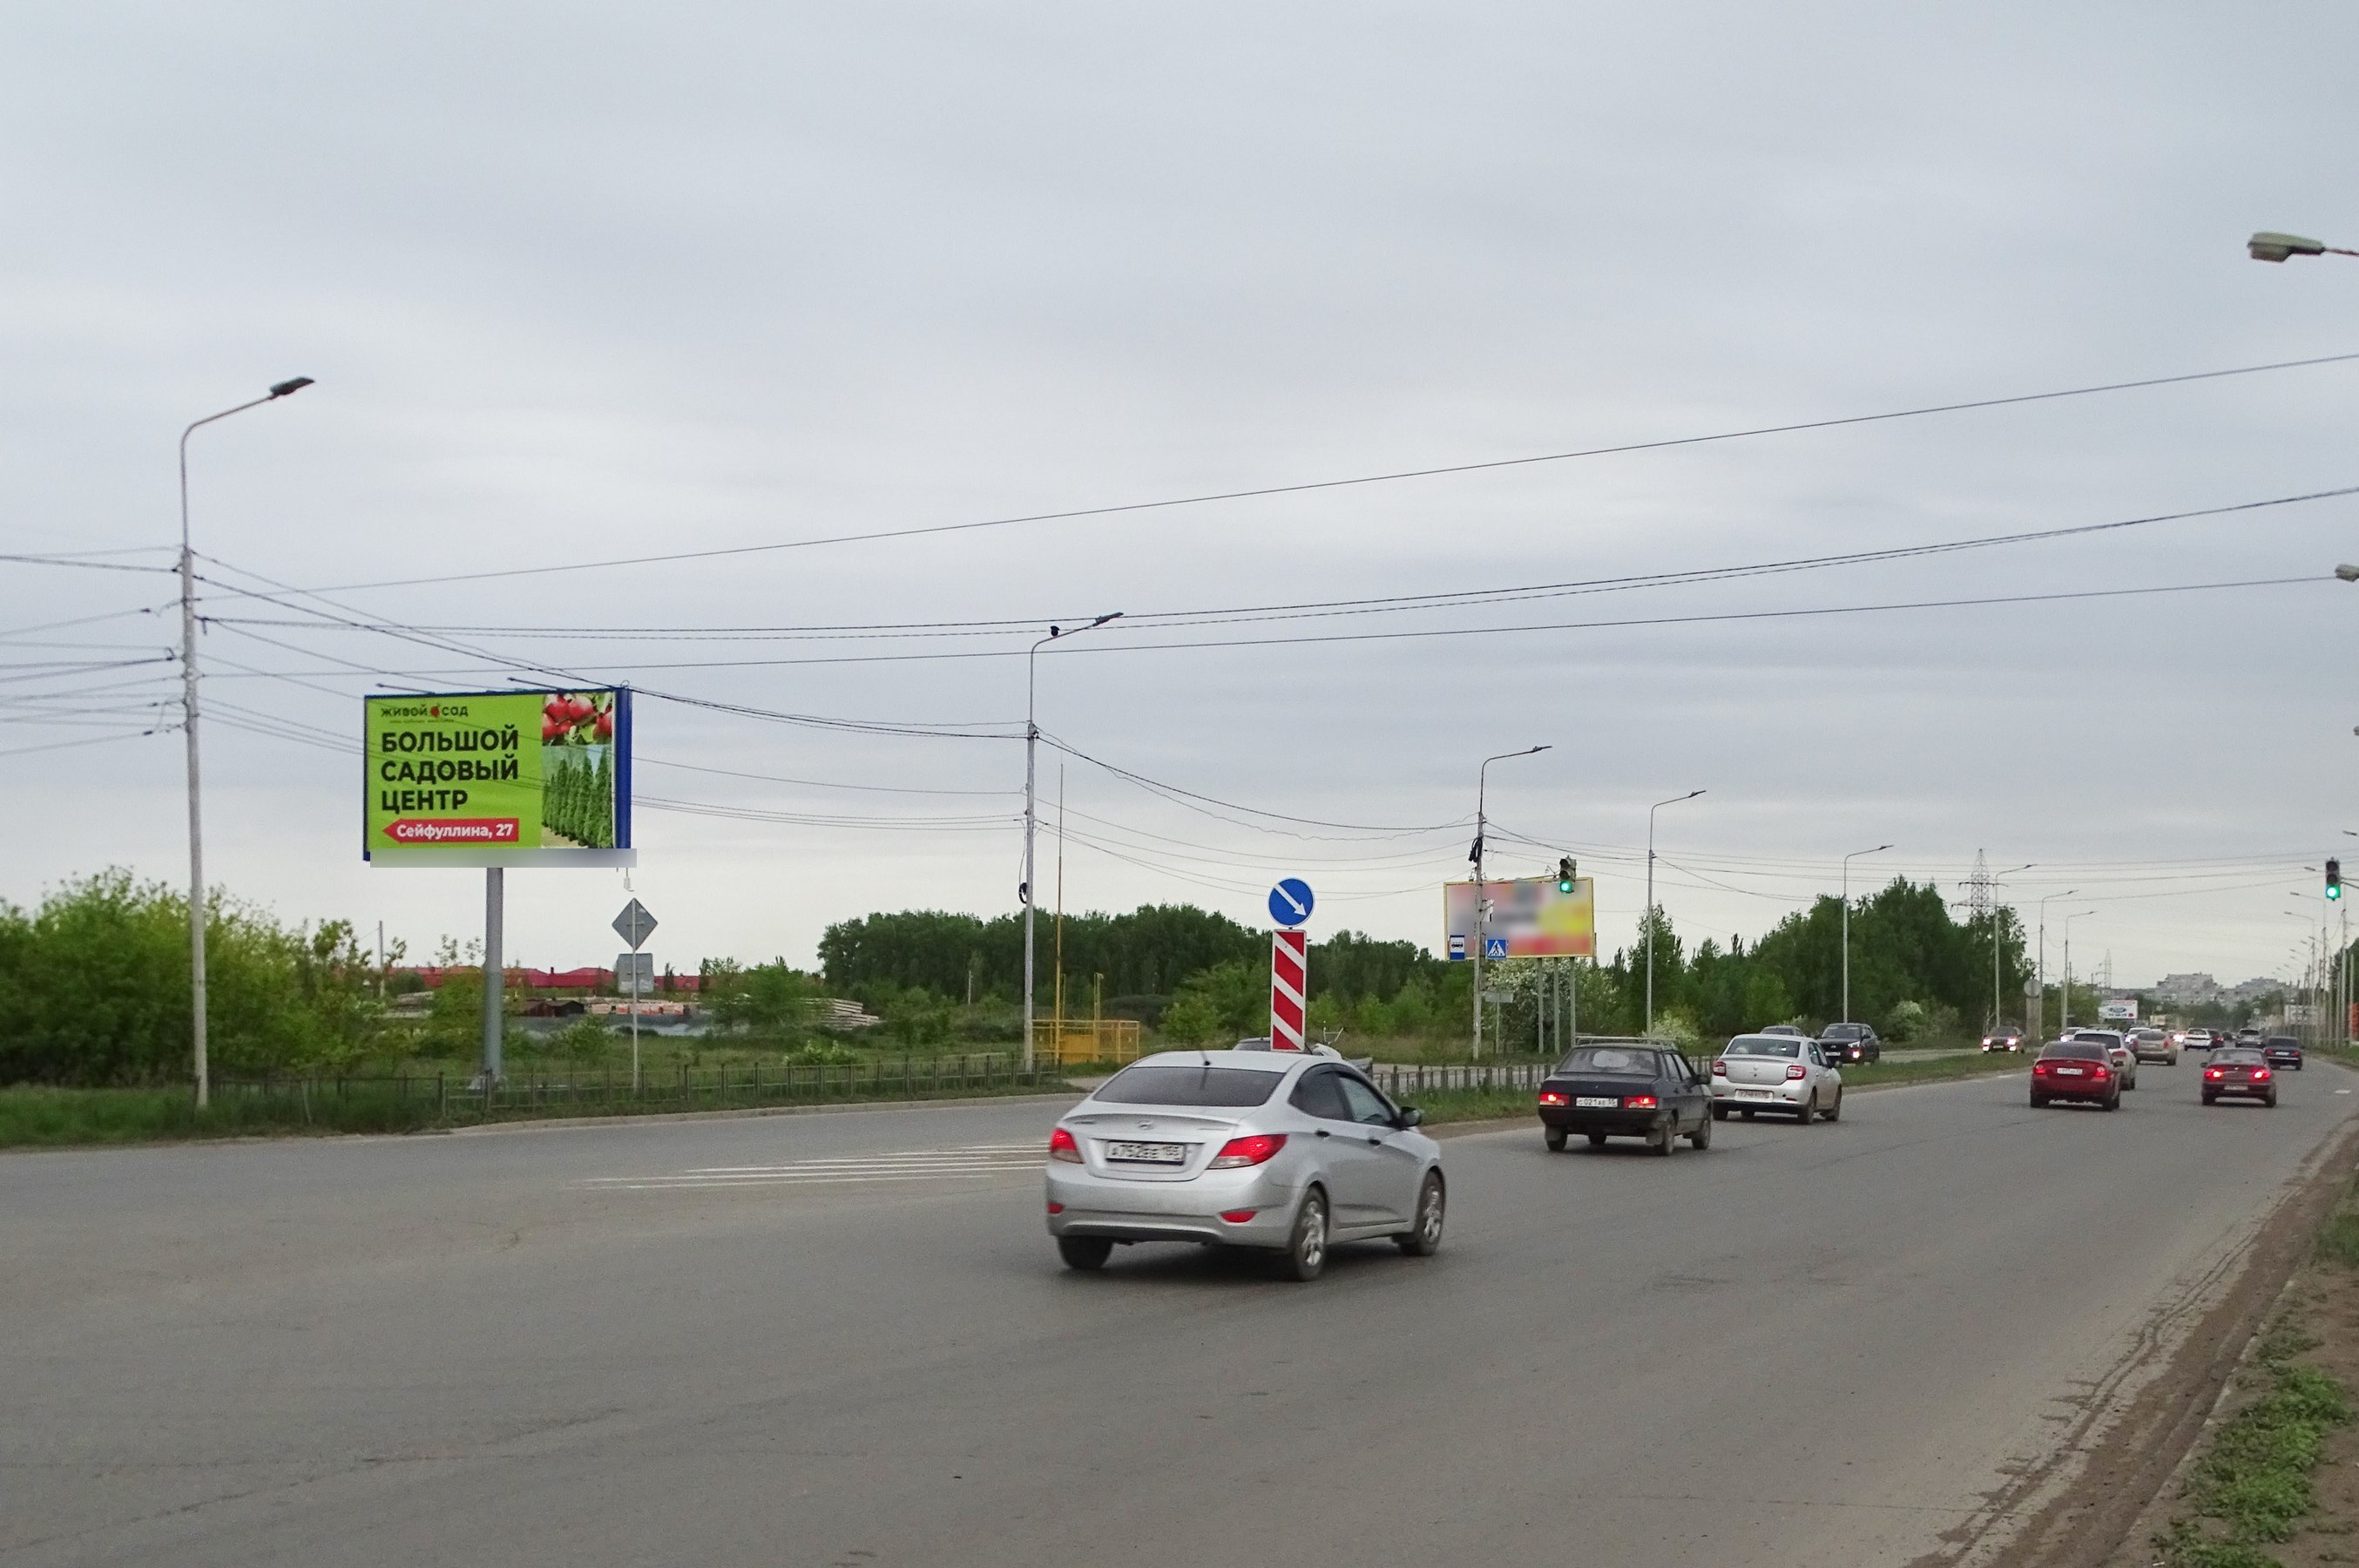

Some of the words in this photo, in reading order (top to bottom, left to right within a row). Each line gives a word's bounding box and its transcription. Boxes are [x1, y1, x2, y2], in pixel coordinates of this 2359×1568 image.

[382, 724, 518, 753] БОЛЬШОЙ
[381, 754, 518, 785] САДОВЫЙ
[382, 790, 468, 814] ЦЕНТР
[396, 824, 493, 840] Сейфуллина,
[496, 823, 514, 836] 27
